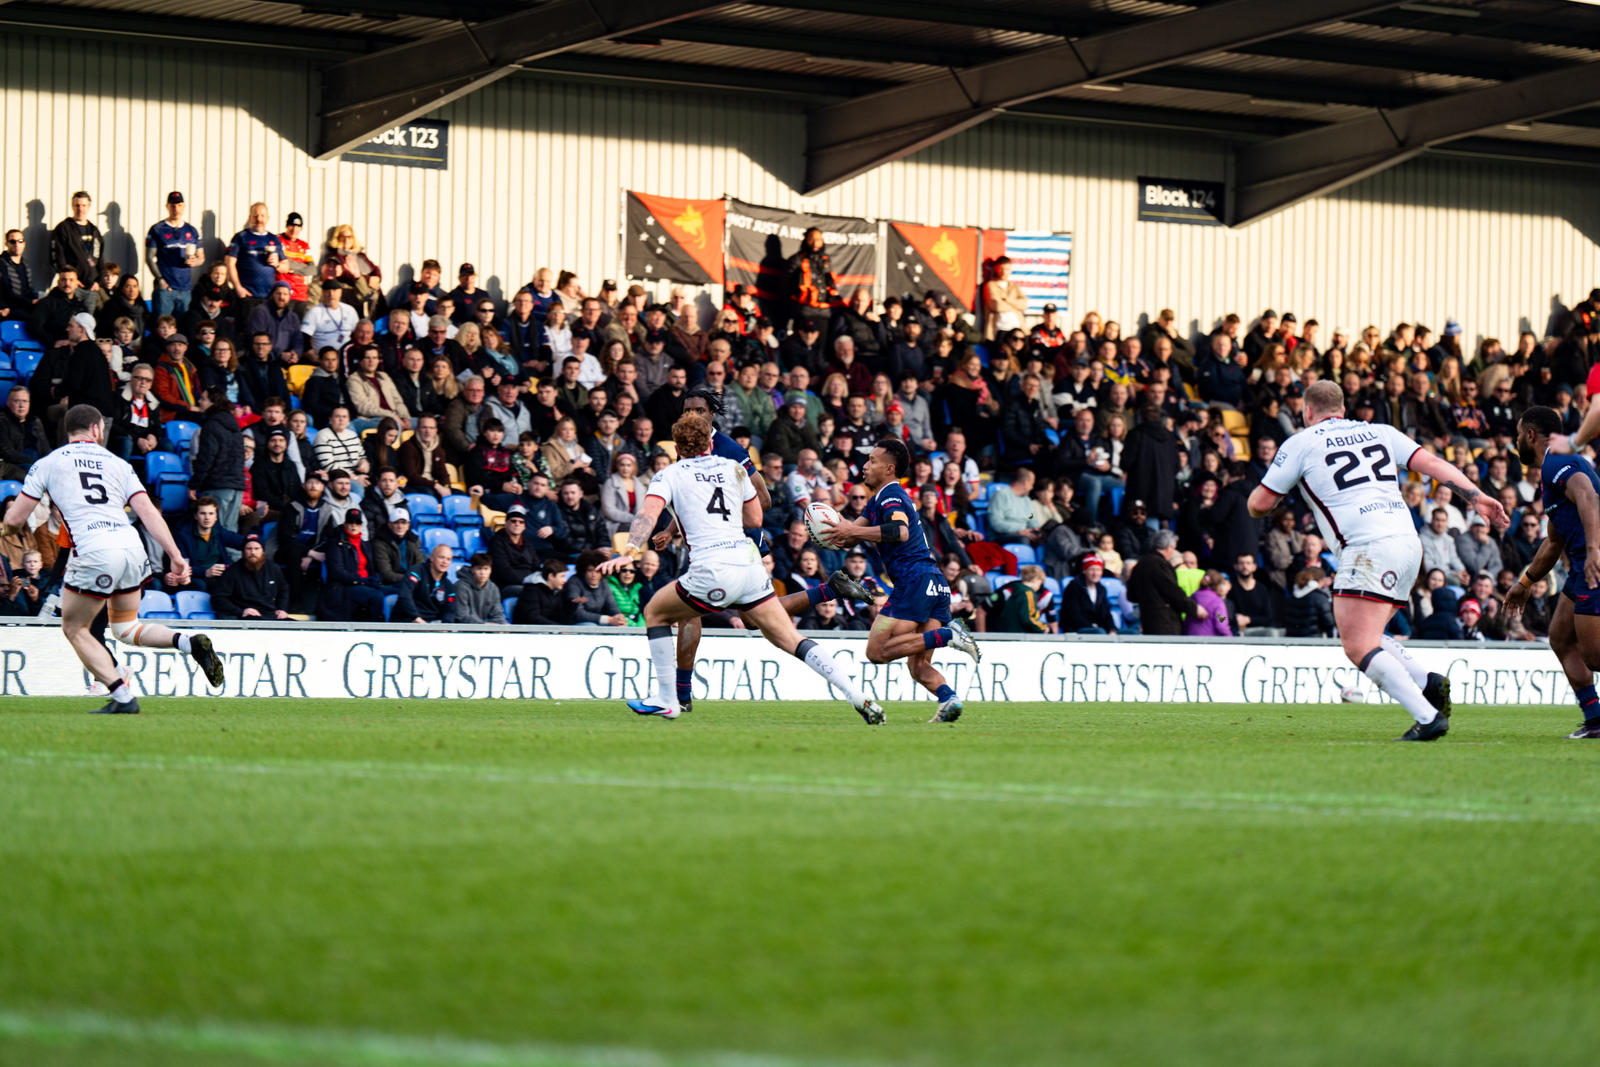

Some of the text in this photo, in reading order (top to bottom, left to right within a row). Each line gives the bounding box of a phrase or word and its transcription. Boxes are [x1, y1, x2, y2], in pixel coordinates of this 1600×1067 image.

[366, 126, 439, 149] ock 123
[1145, 185, 1216, 208] Block 124
[729, 213, 754, 229] NOT
[752, 220, 779, 235] JUST
[779, 225, 789, 237] A
[74, 458, 104, 470] INCE
[1325, 444, 1397, 491] 22
[79, 472, 109, 505] 5
[706, 487, 732, 521] 4
[87, 520, 112, 531] AUSTIN
[343, 642, 552, 699] GREYSTAR
[1039, 652, 1213, 703] GREYSTAR
